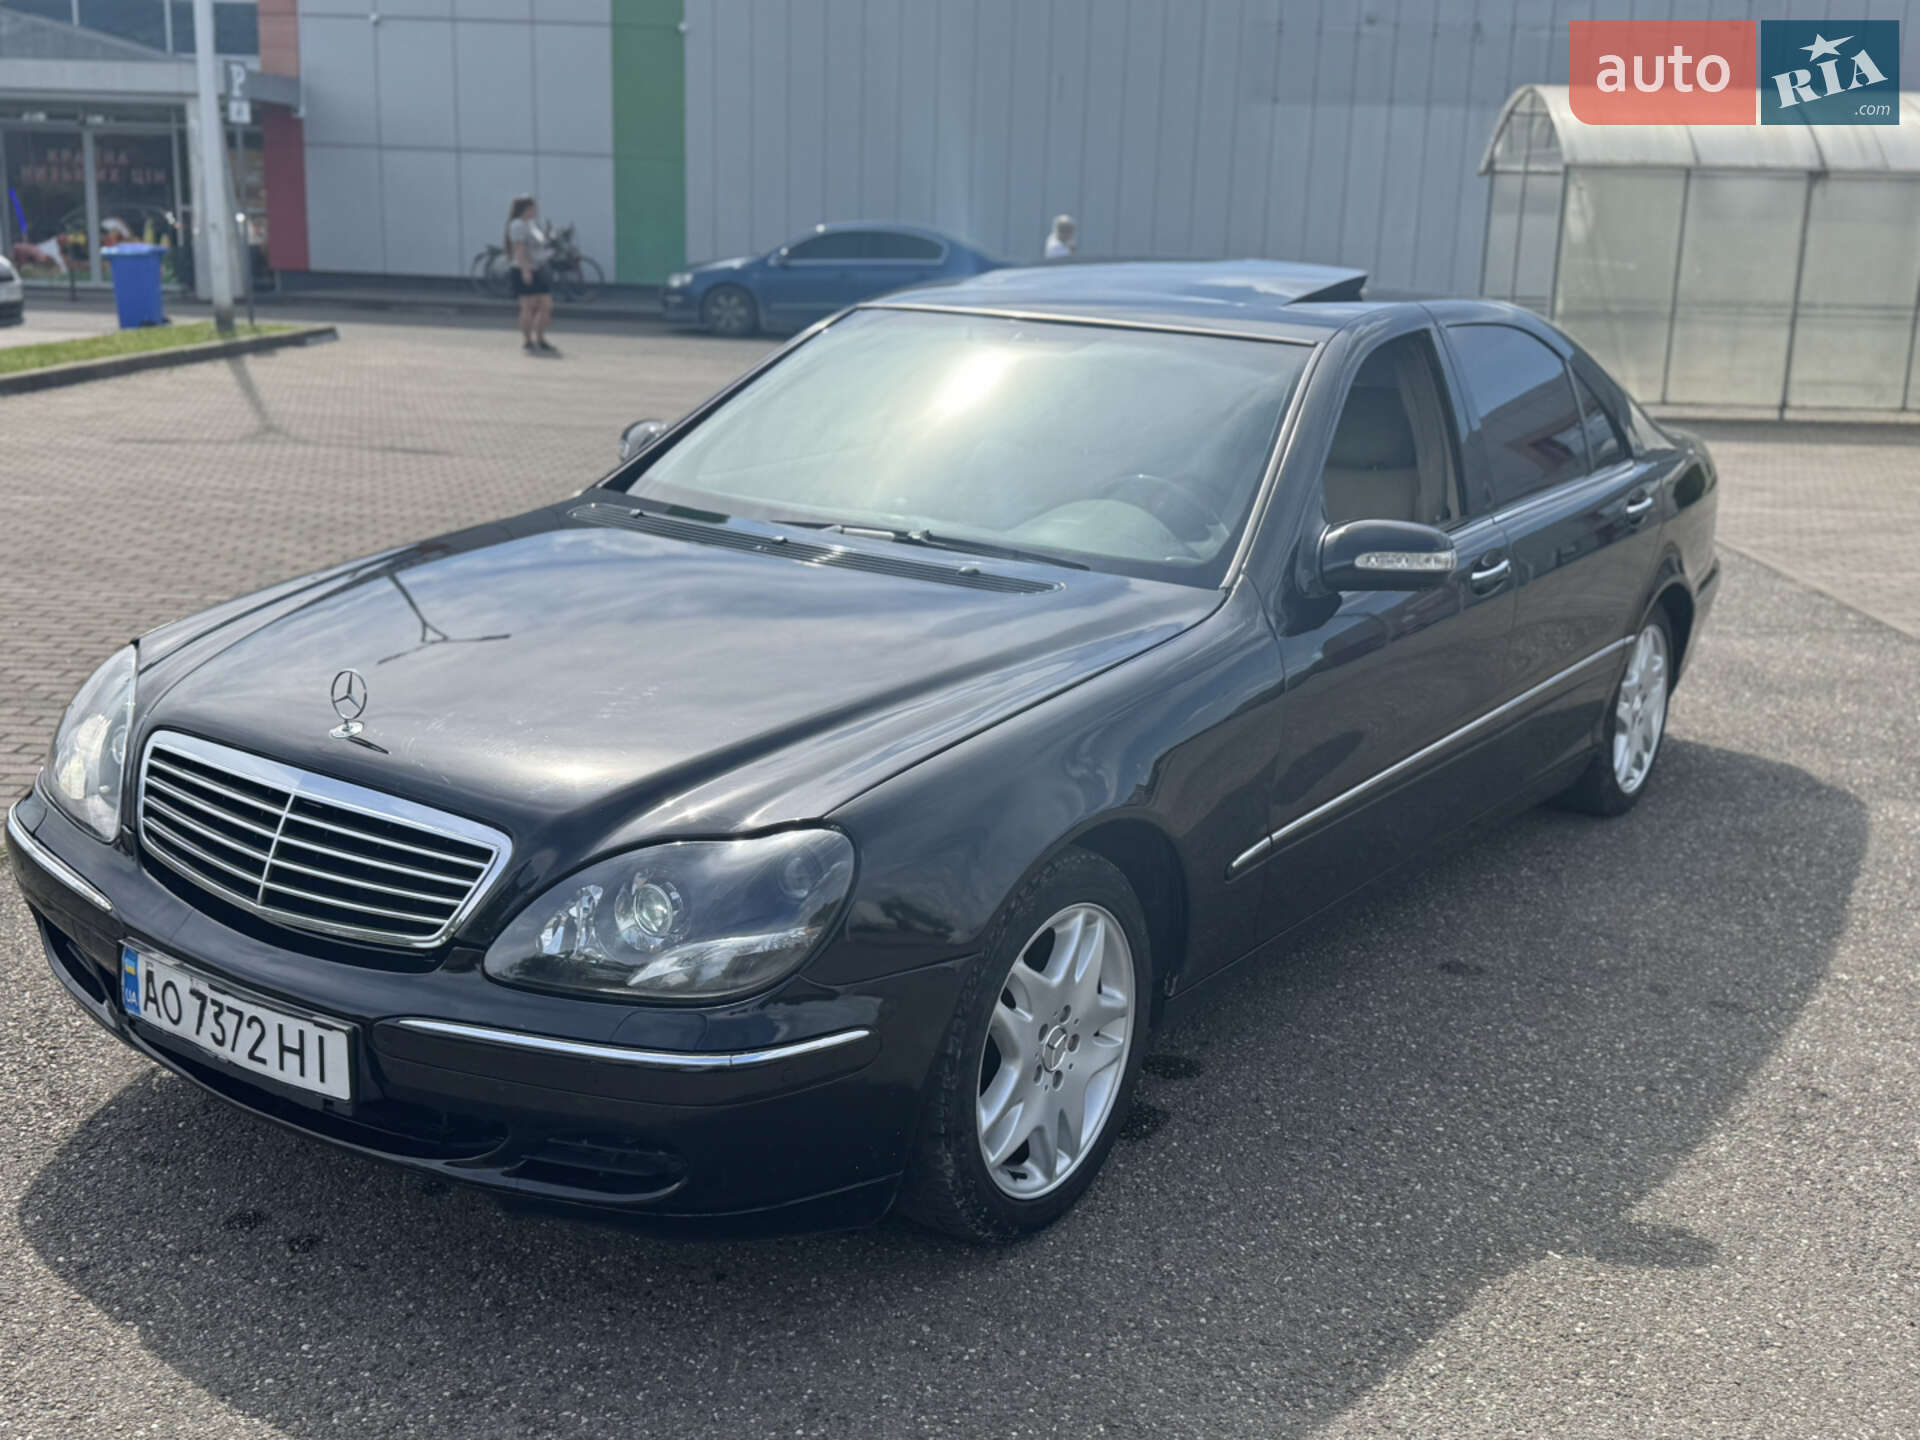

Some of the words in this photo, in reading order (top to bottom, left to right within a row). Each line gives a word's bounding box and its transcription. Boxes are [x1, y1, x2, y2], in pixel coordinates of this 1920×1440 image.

[230, 63, 246, 97] P
[143, 969, 182, 1026] AO
[189, 986, 268, 1066] 7372
[277, 1023, 326, 1084] HI
